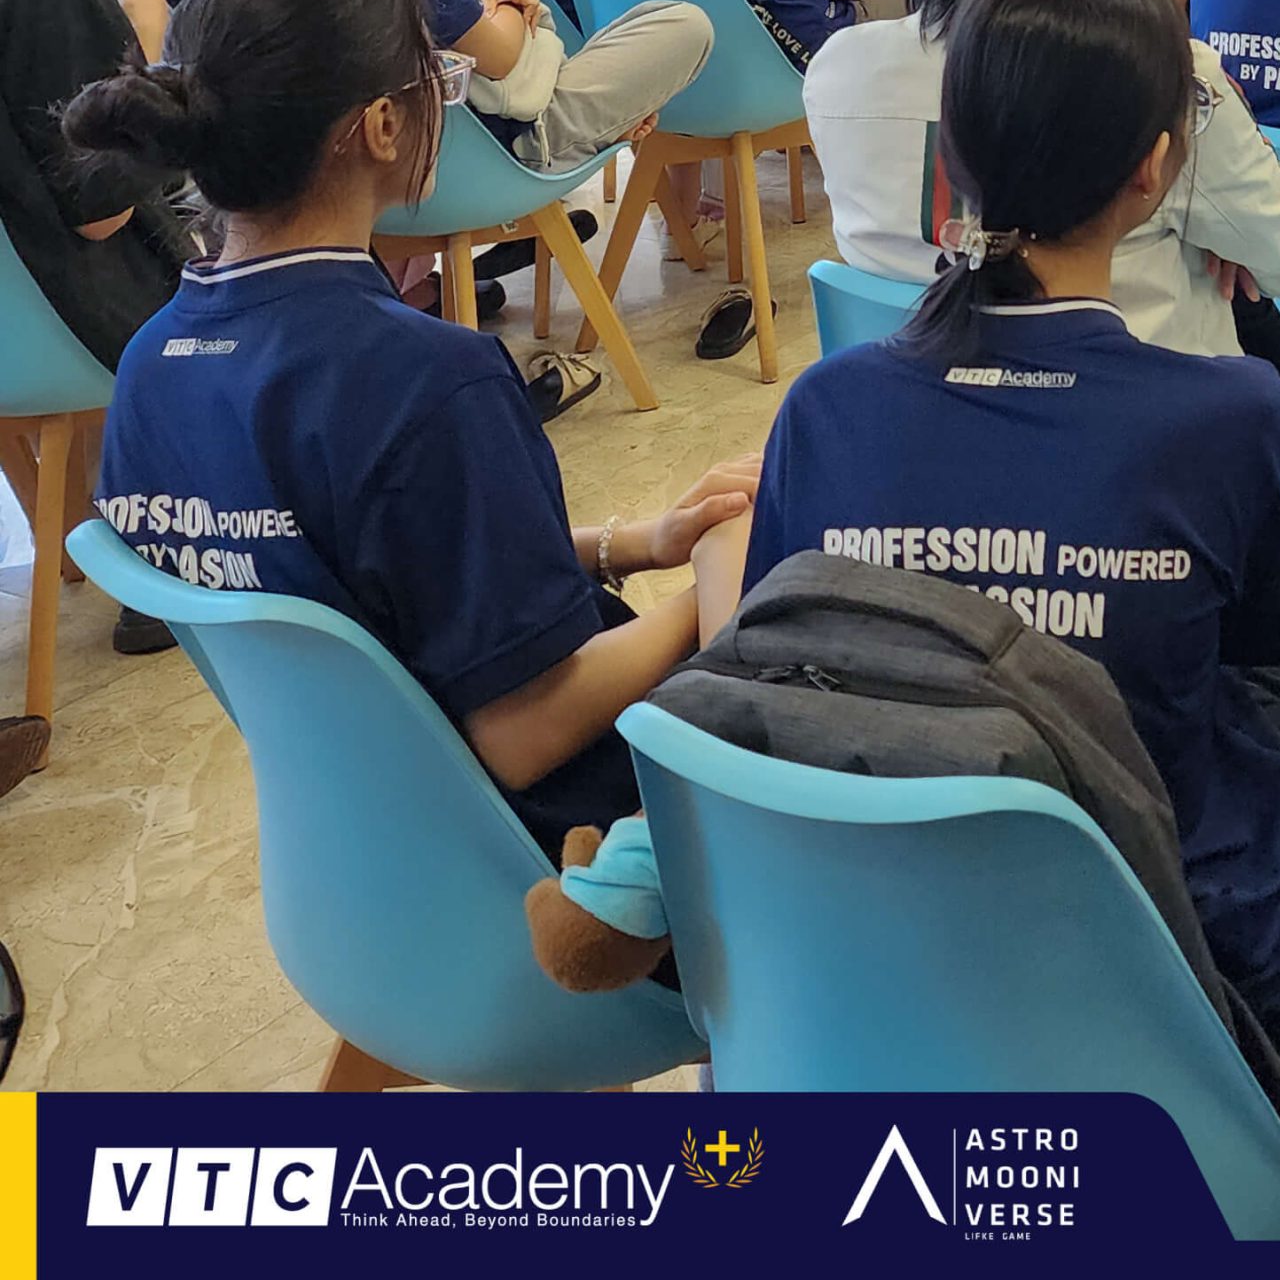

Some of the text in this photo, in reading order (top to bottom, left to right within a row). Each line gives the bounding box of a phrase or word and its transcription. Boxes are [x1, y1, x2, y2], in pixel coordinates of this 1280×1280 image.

[771, 18, 802, 54] LOVE
[1240, 64, 1260, 81] BY
[162, 337, 239, 356] VTC Academy
[945, 368, 1077, 388] VTC Academy
[1056, 544, 1191, 581] POWERED
